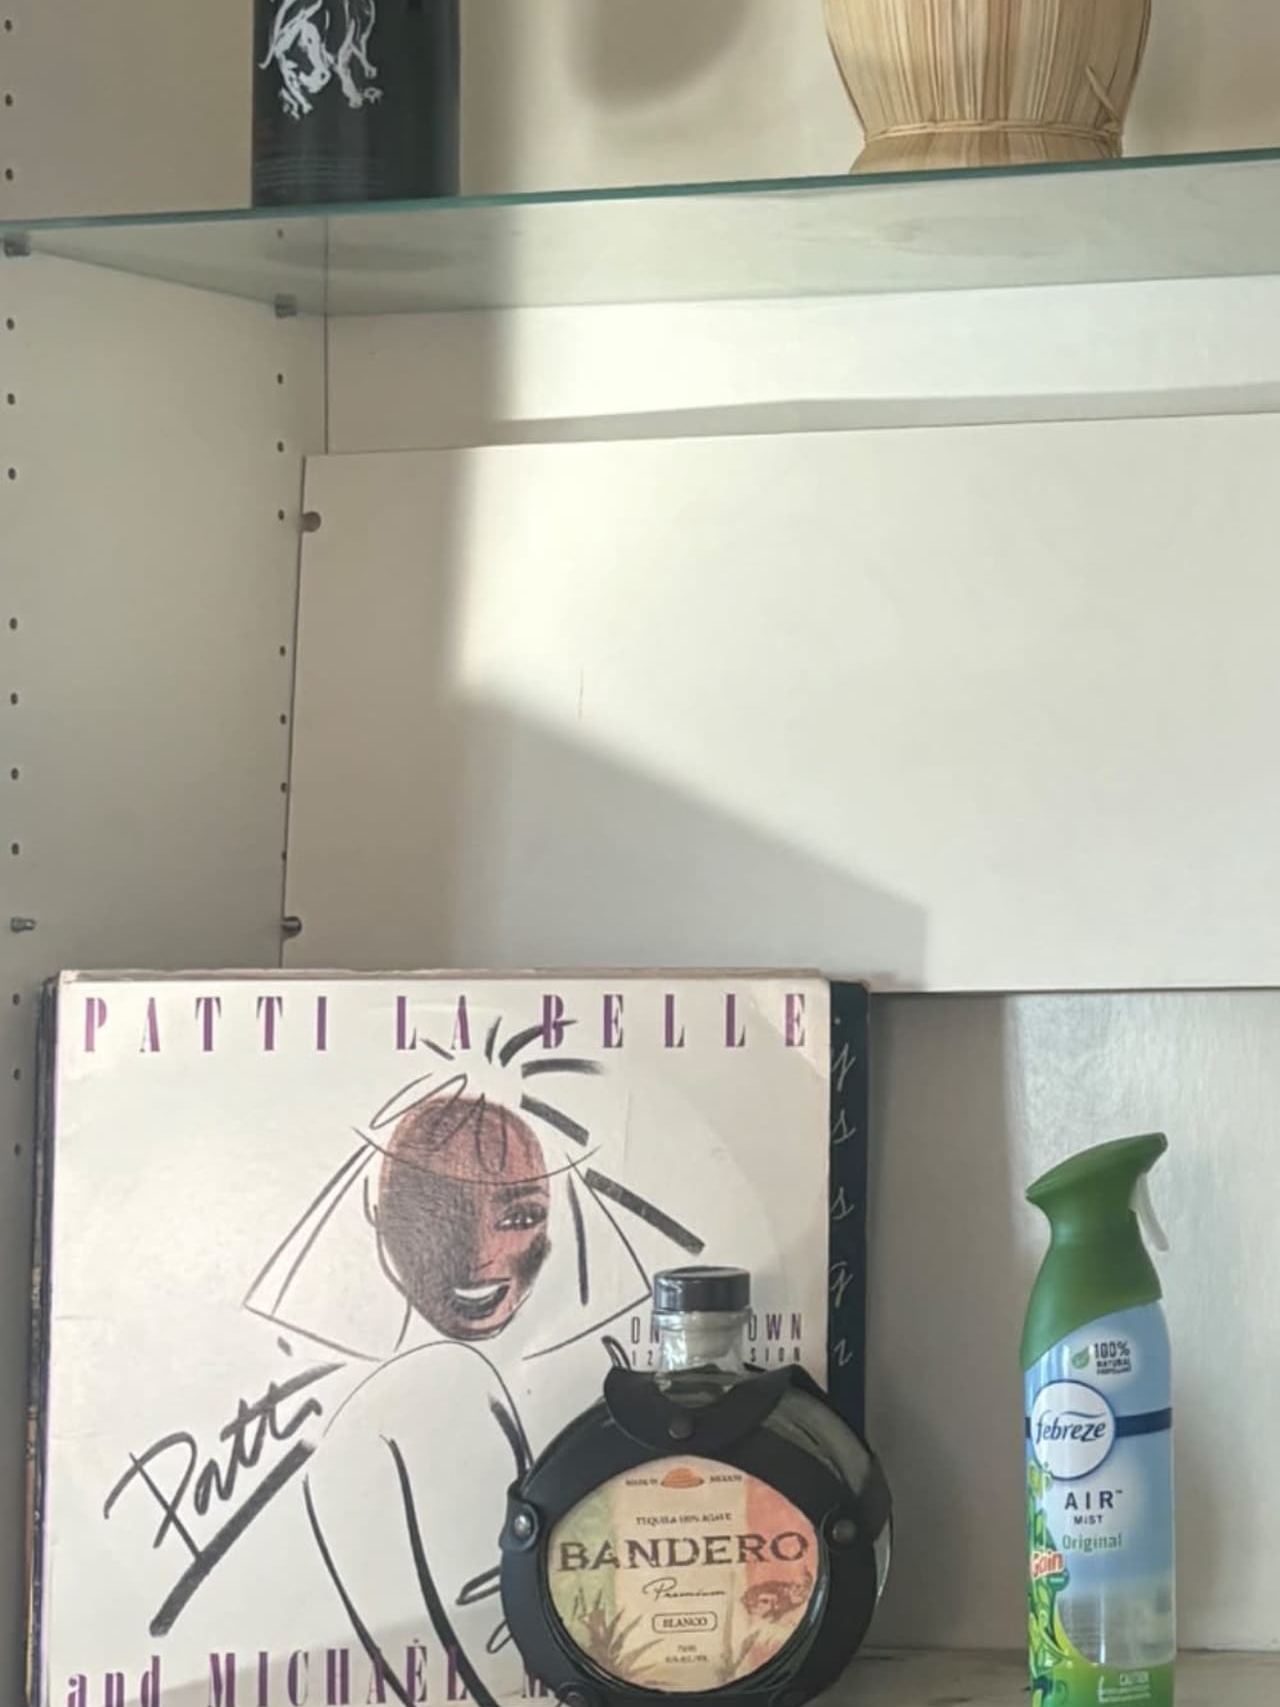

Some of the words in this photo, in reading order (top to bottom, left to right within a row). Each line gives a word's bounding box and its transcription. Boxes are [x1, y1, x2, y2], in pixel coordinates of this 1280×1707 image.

[83, 995, 327, 1053] PATTI
[396, 995, 471, 1051] LA
[541, 993, 806, 1049] BELLE
[1093, 1341, 1131, 1359] 100%
[1036, 1409, 1107, 1445] febreze
[103, 1336, 348, 1559] Patti
[1064, 1490, 1114, 1510] AIR
[558, 1531, 809, 1573] BANDERO
[1062, 1532, 1123, 1553] Original
[642, 1576, 726, 1602] Premium
